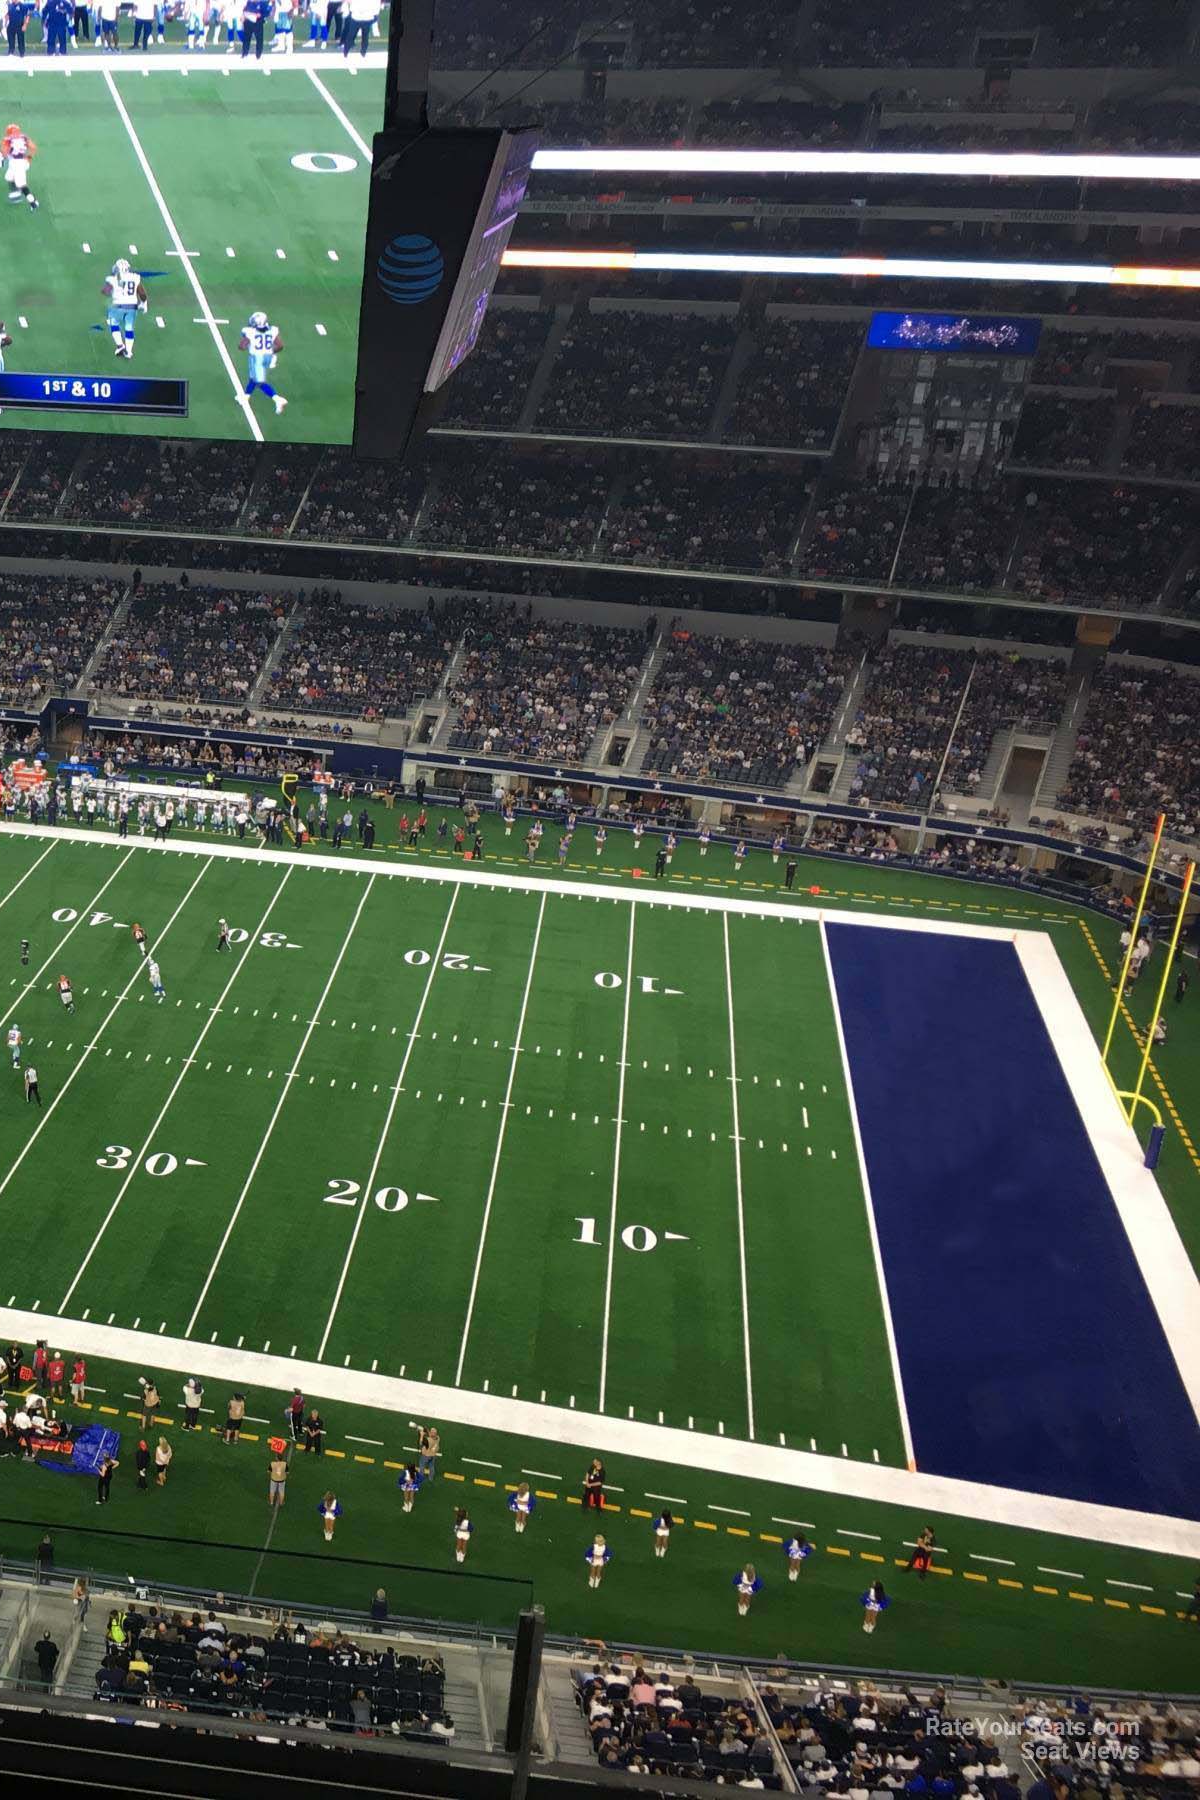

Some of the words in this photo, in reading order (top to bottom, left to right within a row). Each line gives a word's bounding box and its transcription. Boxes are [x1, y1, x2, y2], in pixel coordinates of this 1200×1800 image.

[42, 380, 68, 396] 1ST
[71, 381, 86, 397] &
[91, 382, 111, 398] 10
[96, 1145, 178, 1176] 30
[323, 1179, 409, 1211] 20
[572, 1218, 657, 1252] 10
